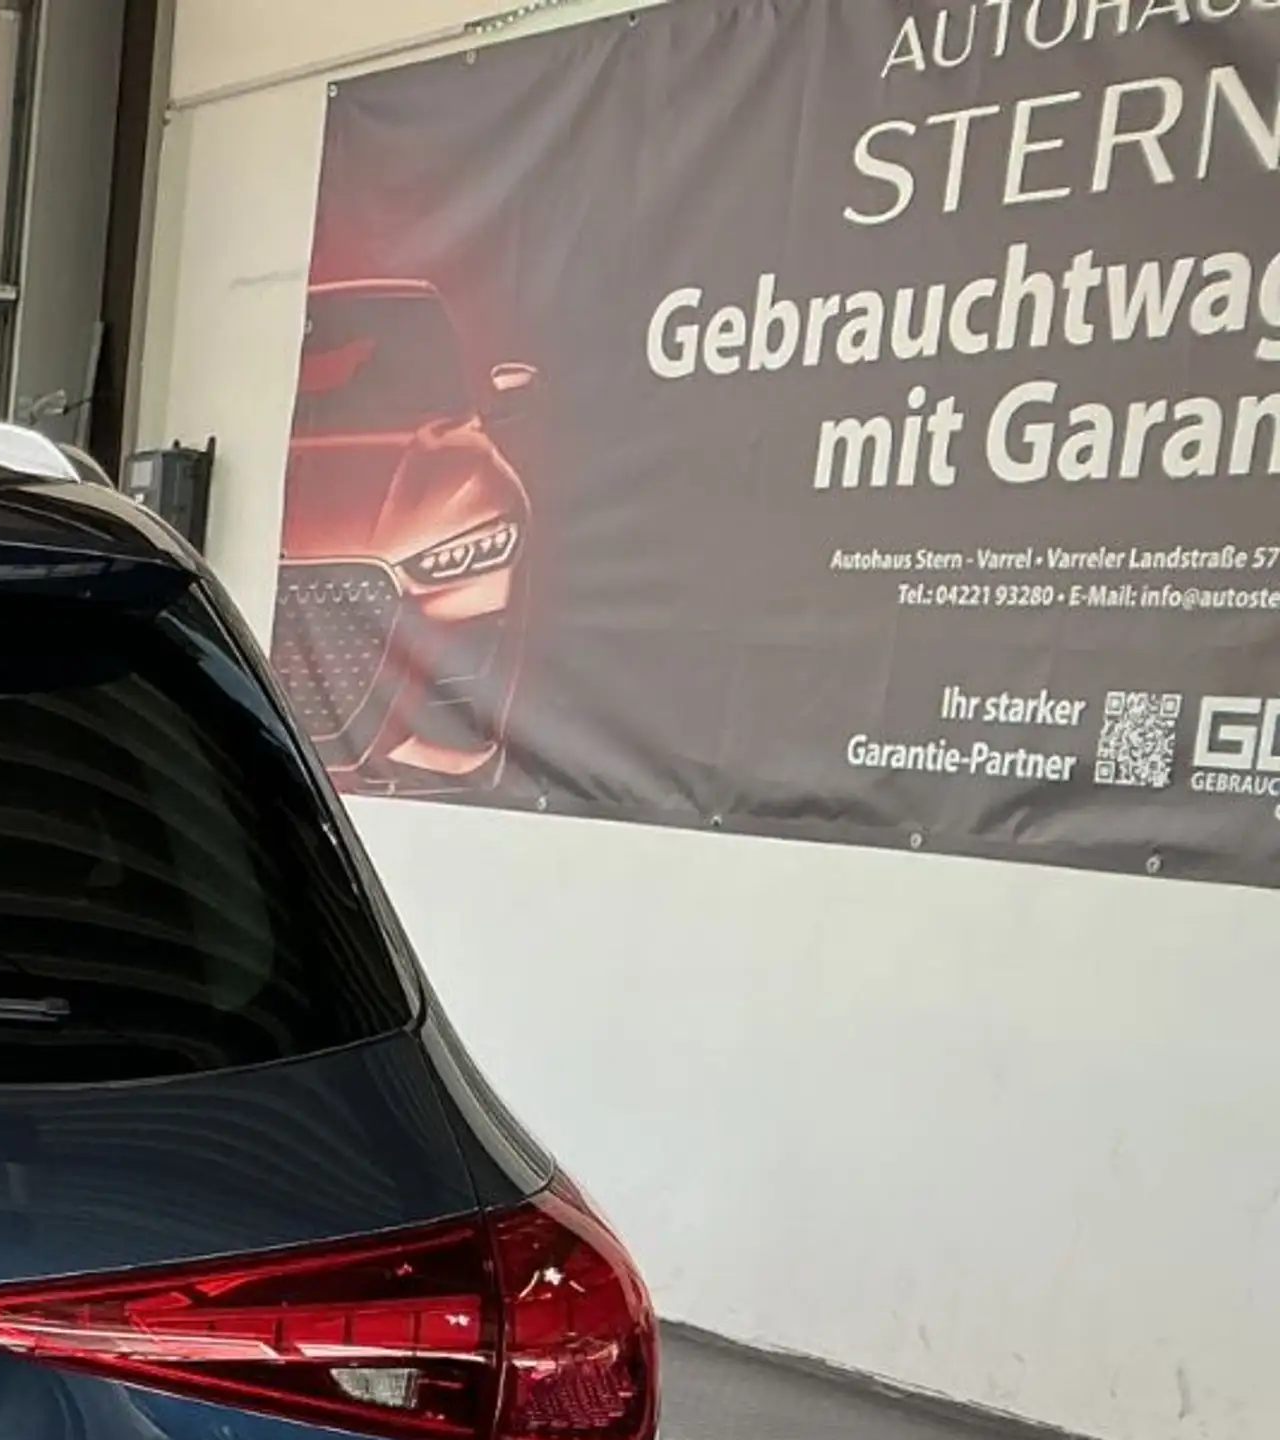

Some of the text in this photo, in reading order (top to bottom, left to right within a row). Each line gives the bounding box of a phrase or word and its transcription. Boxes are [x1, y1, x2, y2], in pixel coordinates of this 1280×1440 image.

[843, 66, 1280, 225] STERN
[813, 380, 1280, 489] mit Garan
[830, 548, 912, 570] Autohaus
[914, 549, 963, 569] Stern
[977, 547, 1033, 569] Varrel
[1046, 546, 1125, 569] Varreler
[1129, 545, 1248, 569] Landstraße
[1251, 547, 1280, 569] 57
[898, 583, 933, 604] Tel.:
[936, 585, 990, 605] 04221
[995, 585, 1054, 606] 93280
[1068, 585, 1137, 606] E-Mail:
[941, 686, 1086, 726] Ihr starker
[847, 734, 1077, 781] Garantie-Partner
